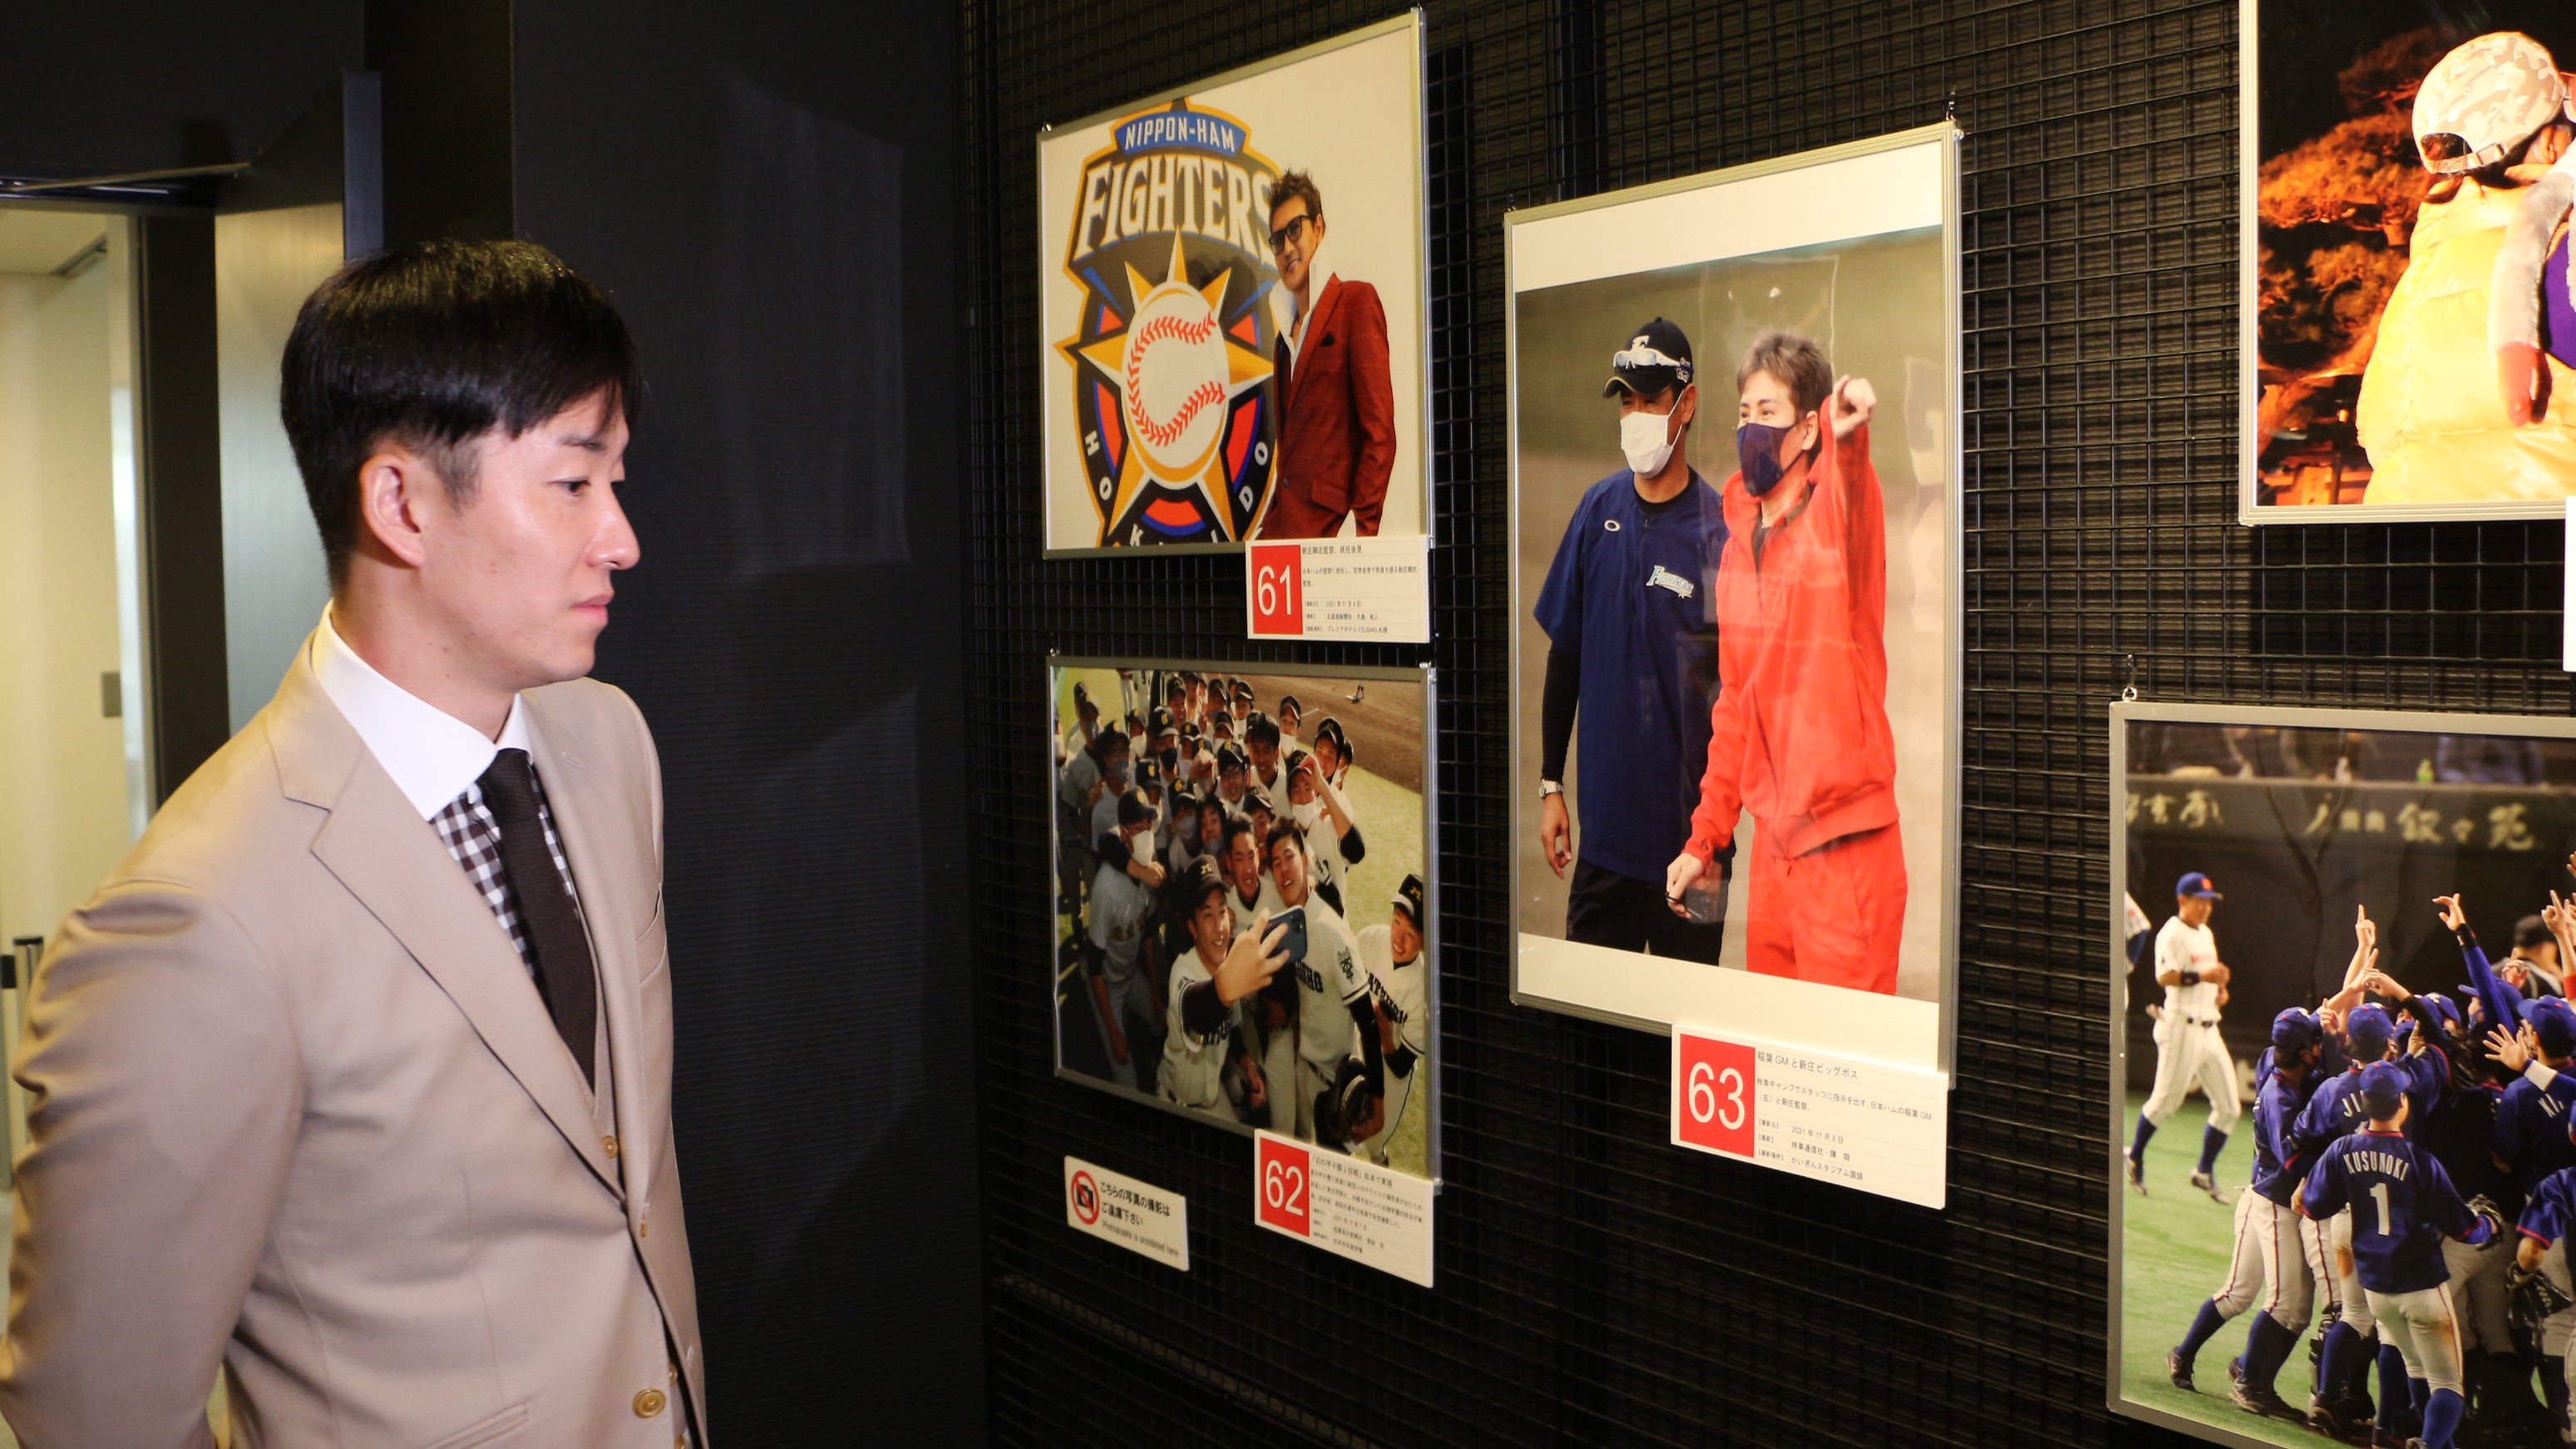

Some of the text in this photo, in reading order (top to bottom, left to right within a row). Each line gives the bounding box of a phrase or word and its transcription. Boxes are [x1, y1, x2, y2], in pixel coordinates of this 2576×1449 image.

[1125, 116, 1235, 153] NIPPON-HAM
[1072, 153, 1278, 264] FIGHTERS
[1258, 565, 1291, 615] 61
[1688, 1062, 1745, 1131] 63
[1266, 1160, 1304, 1217] 62
[2343, 1151, 2410, 1181] KUSUNOKI
[1100, 1181, 1171, 1217] こちらの写真の撮影は
[2370, 1182, 2390, 1236] 1
